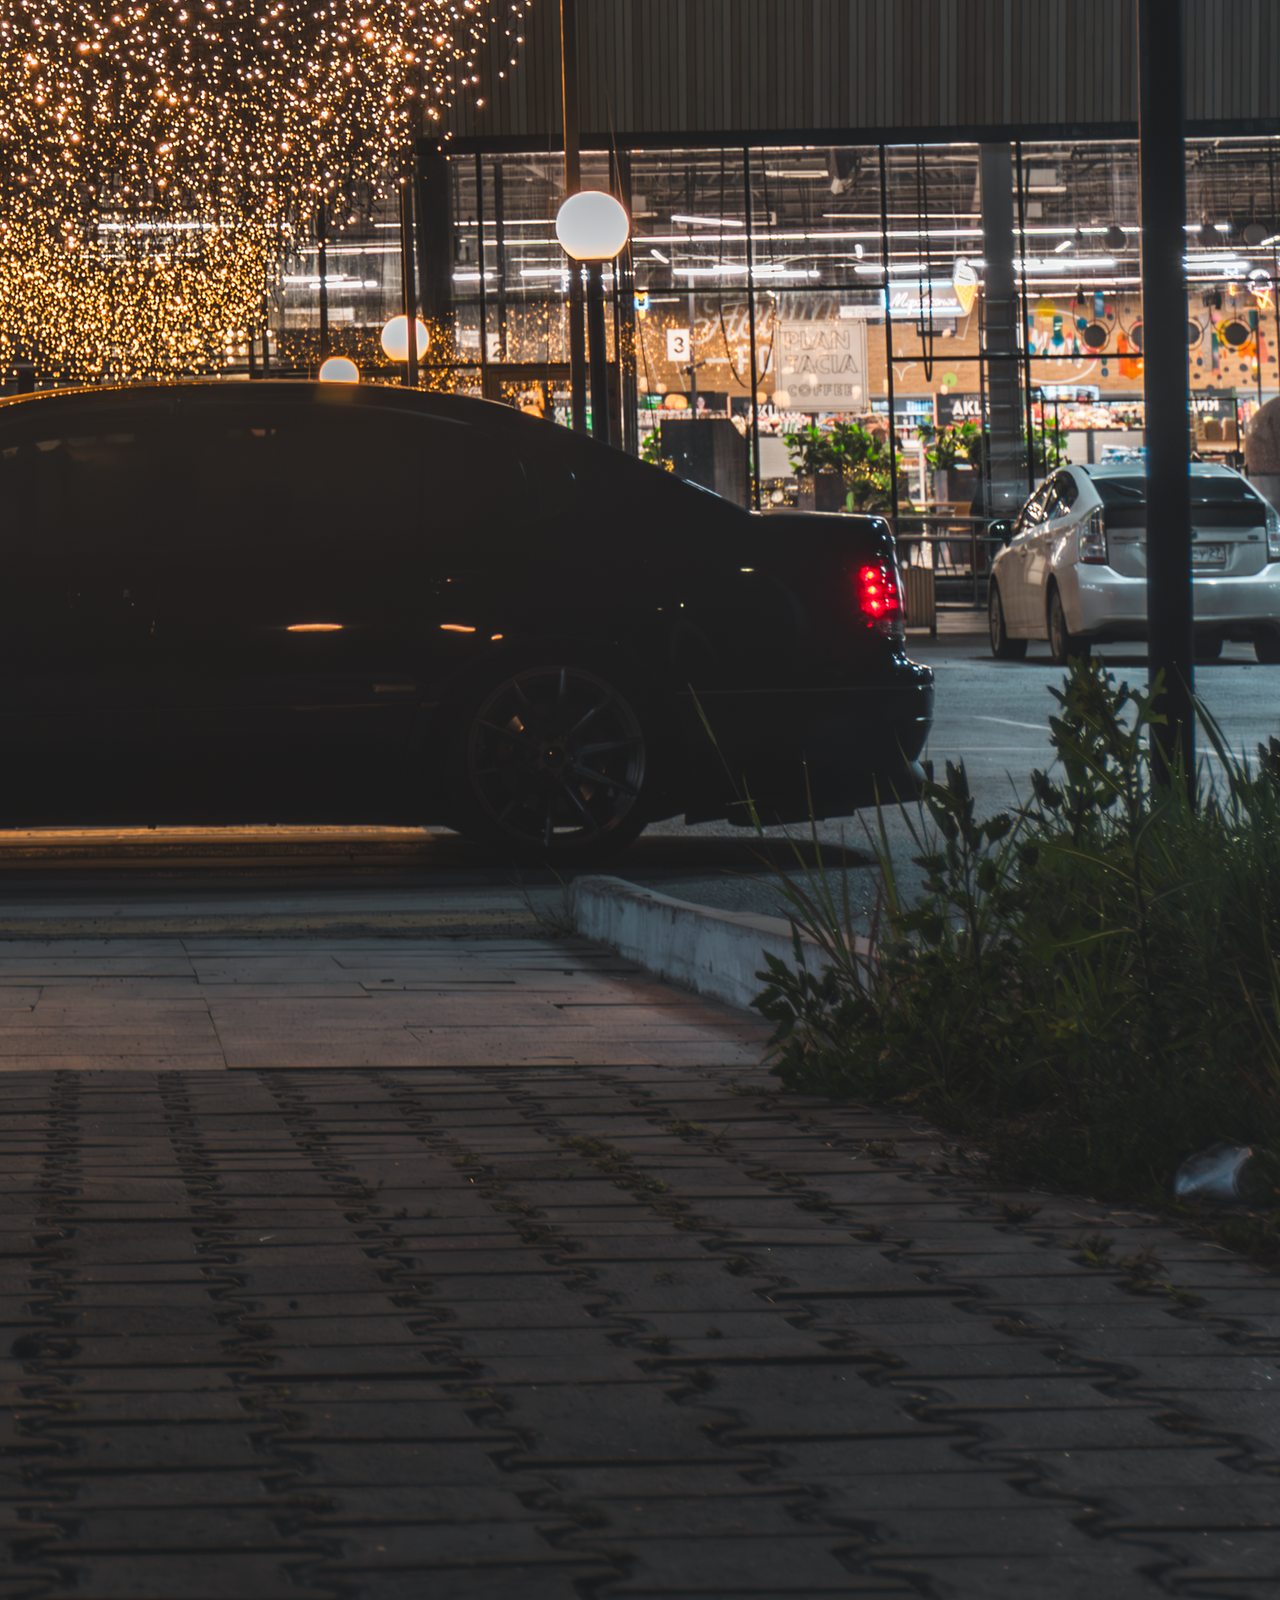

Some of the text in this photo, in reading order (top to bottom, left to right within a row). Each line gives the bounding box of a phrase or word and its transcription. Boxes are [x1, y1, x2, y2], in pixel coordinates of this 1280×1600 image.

[673, 336, 685, 354] 3
[779, 330, 851, 350] PLAN
[787, 383, 853, 397] COFFEE
